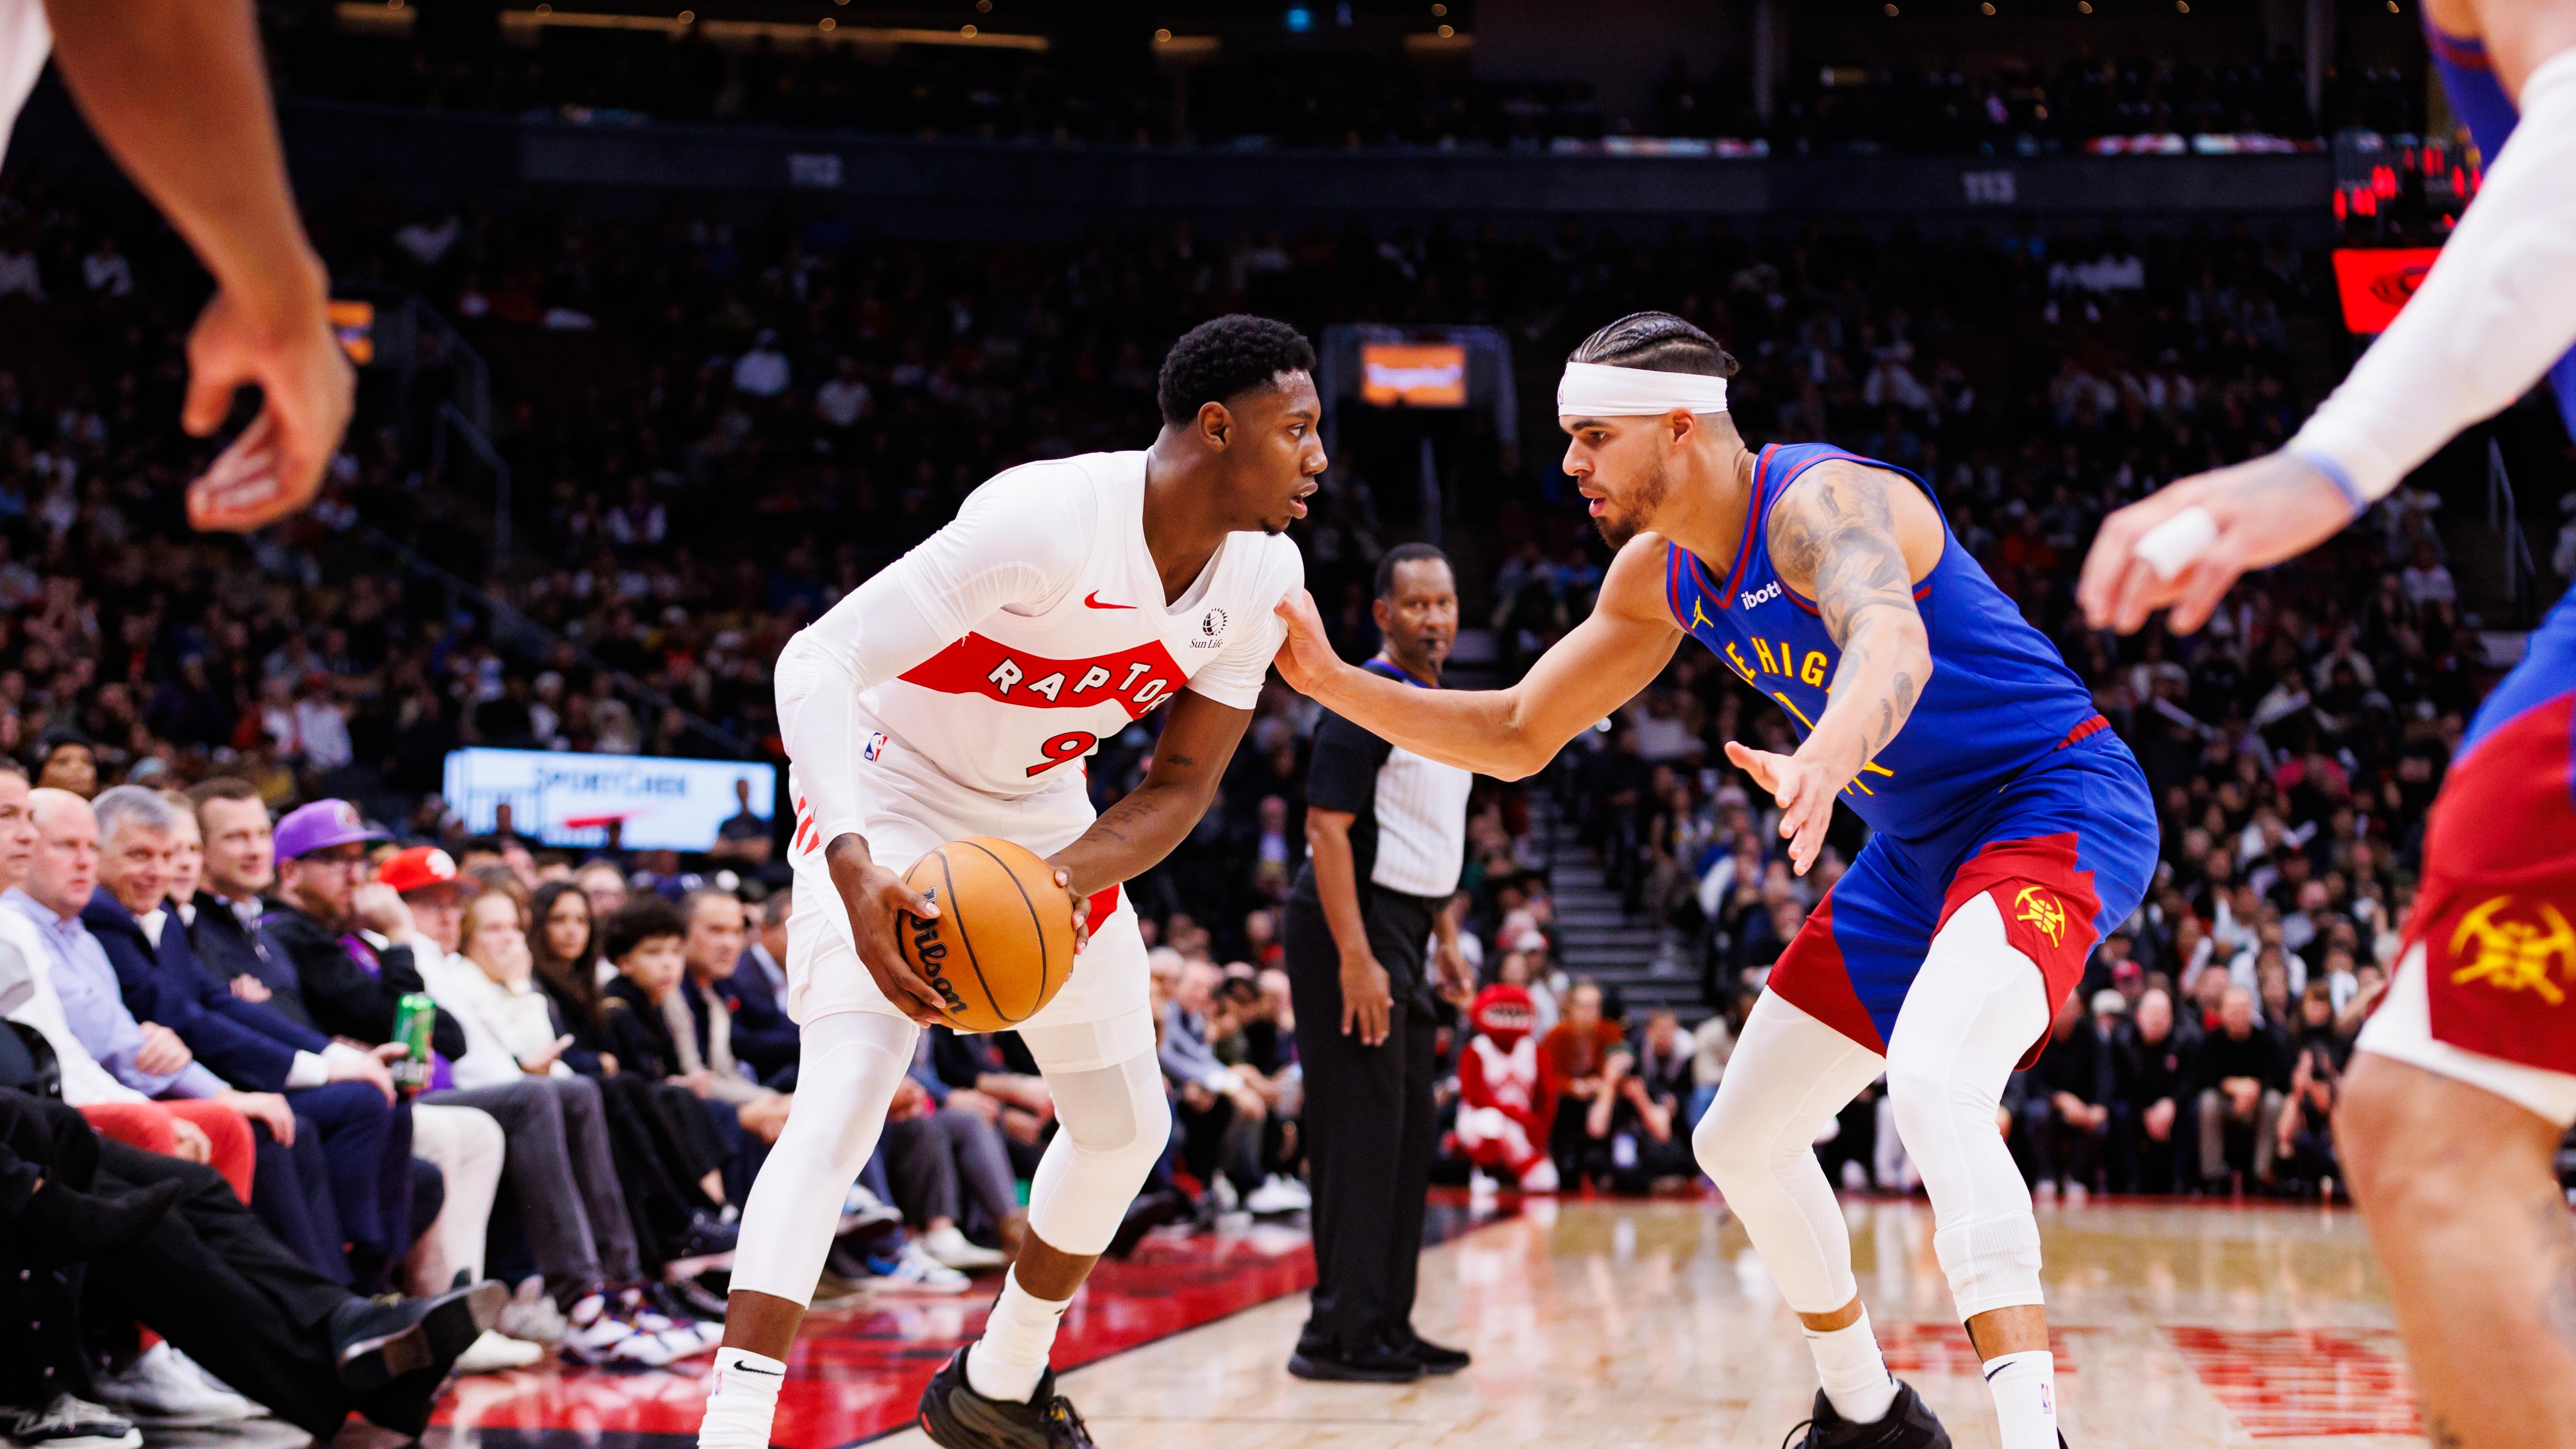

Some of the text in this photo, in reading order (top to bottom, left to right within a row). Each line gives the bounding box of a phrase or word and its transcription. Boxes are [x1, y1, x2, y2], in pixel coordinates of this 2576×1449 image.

[1190, 639, 1223, 648] Sun Life
[1026, 731, 1097, 778] 9
